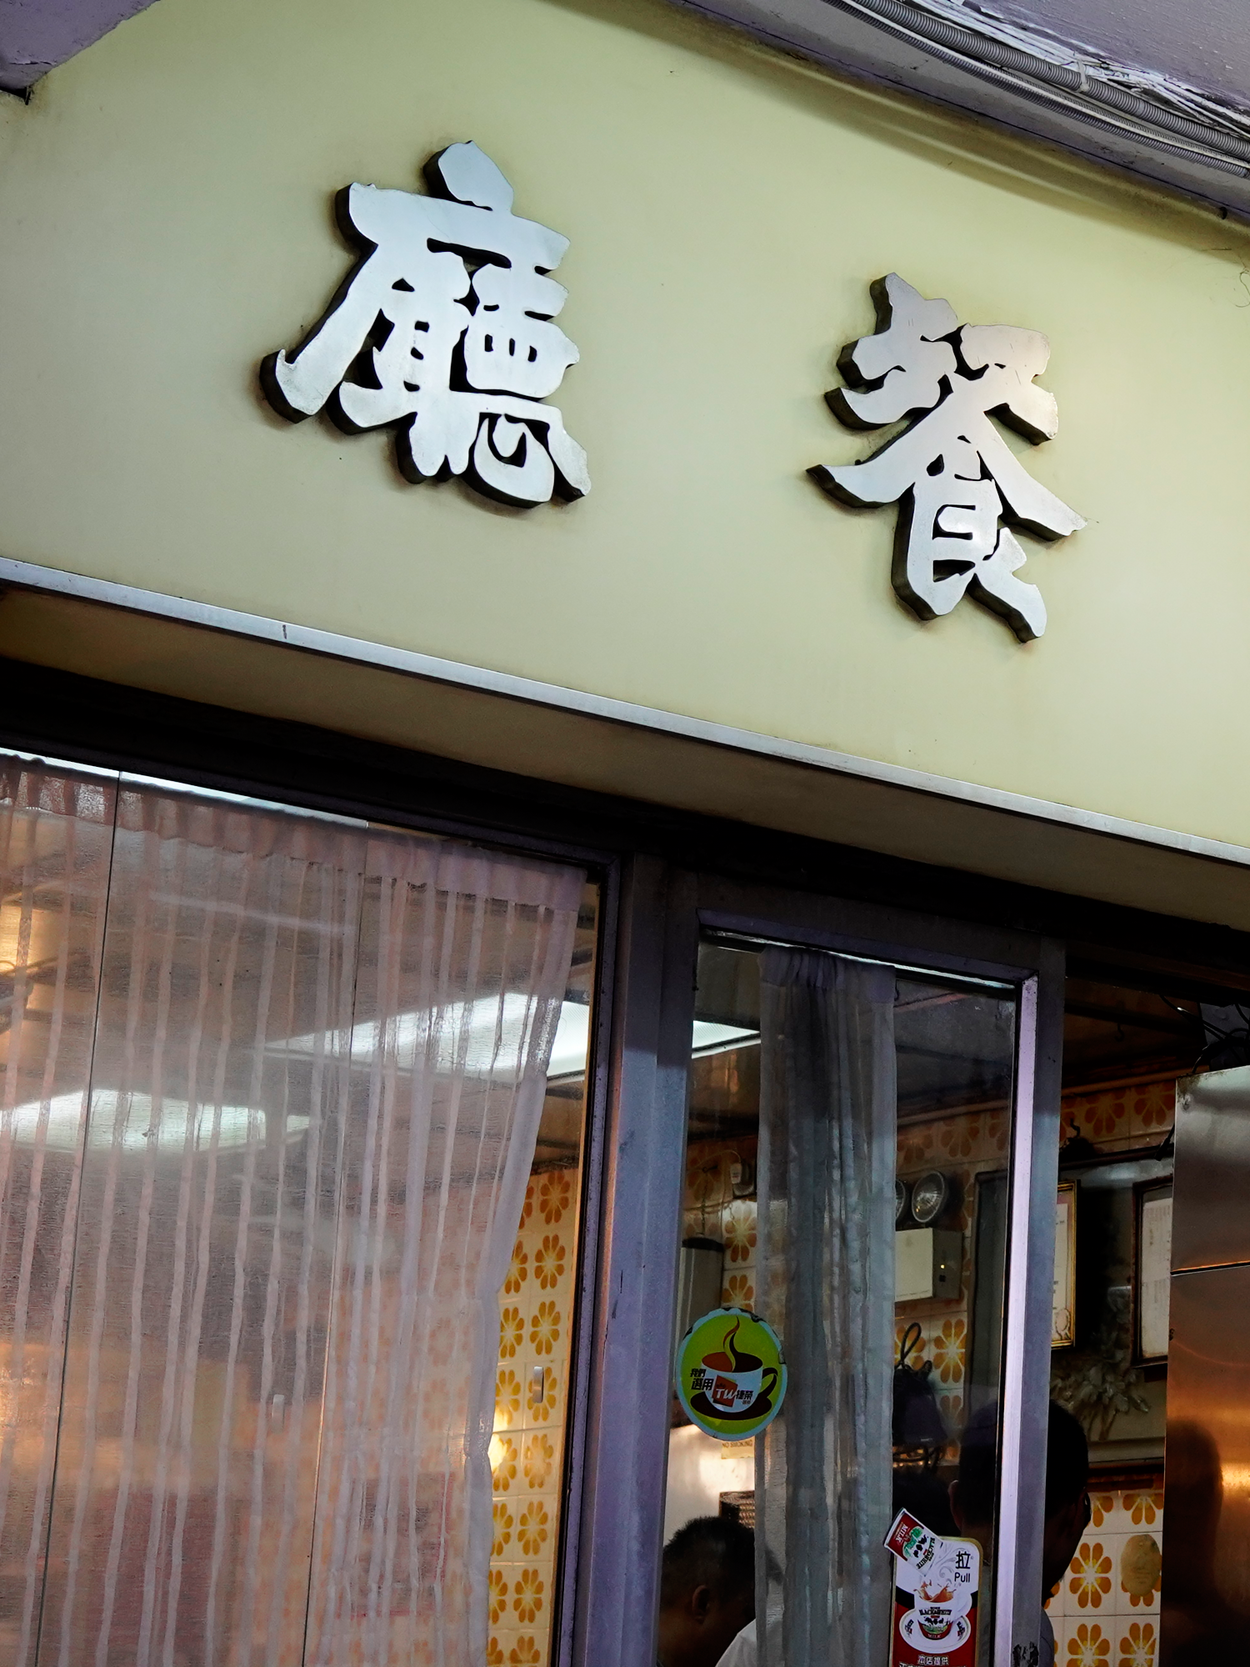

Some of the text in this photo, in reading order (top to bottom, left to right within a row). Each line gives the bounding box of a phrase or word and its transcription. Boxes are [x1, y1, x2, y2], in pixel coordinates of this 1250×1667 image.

[692, 1378, 714, 1391] 選用
[716, 1389, 737, 1400] TW
[895, 1524, 908, 1543] MILK
[955, 1551, 971, 1570] 拉
[954, 1572, 970, 1583] Pull
